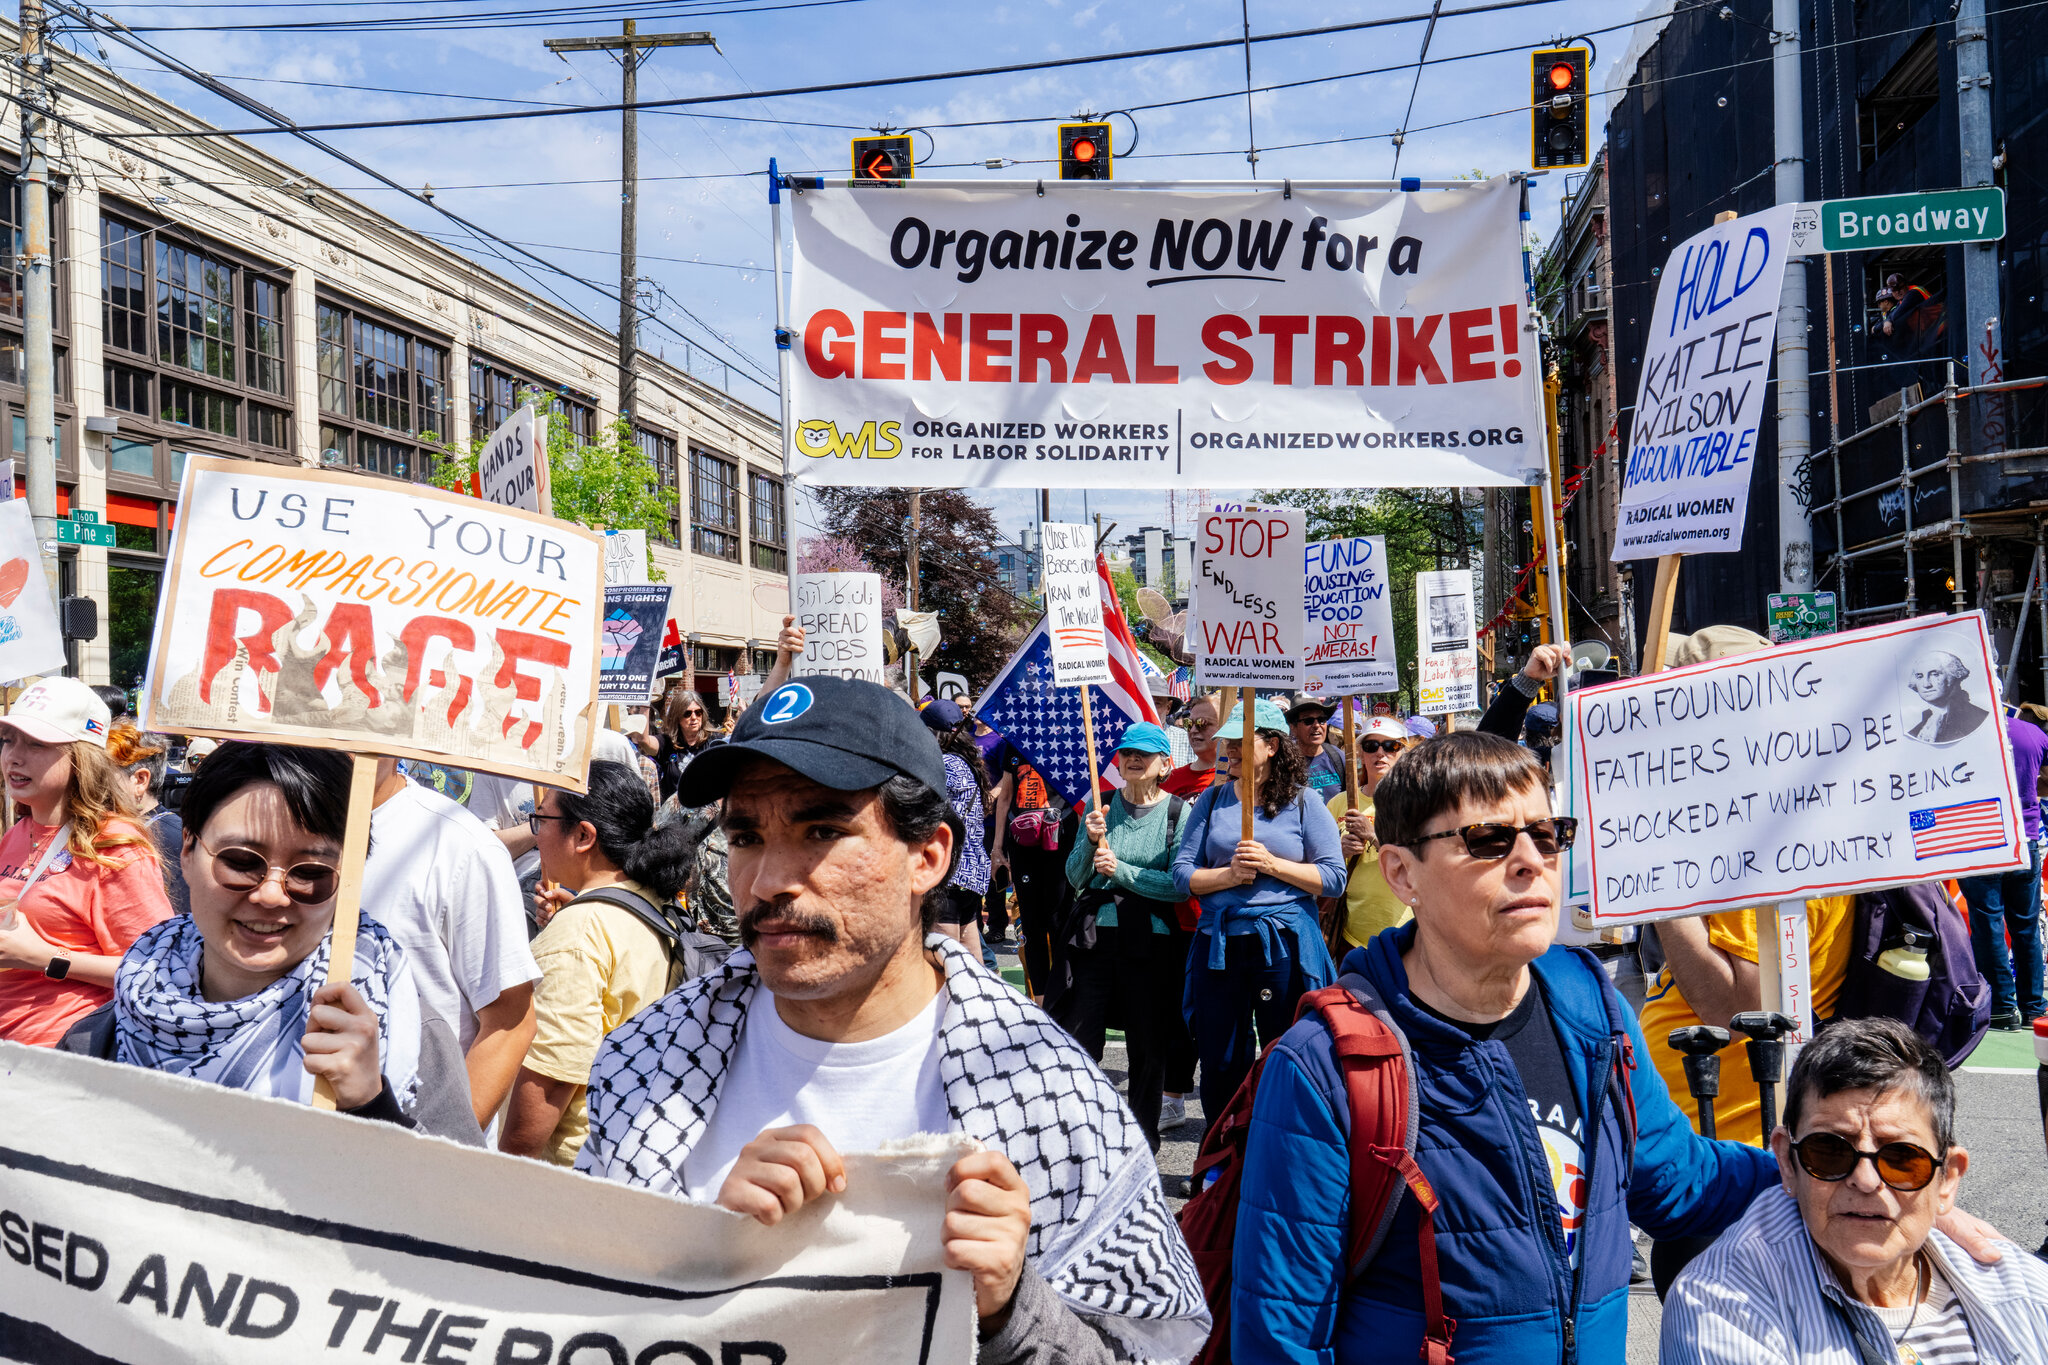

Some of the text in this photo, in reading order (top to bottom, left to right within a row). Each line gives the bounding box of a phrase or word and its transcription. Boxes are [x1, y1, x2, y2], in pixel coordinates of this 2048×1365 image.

[1792, 220, 1817, 230] RTS
[1839, 206, 1989, 239] Broadway
[890, 213, 1423, 283] Organize NOW for a
[1669, 226, 1770, 338] HOLD
[804, 303, 1522, 387] GENERAL STRIKE!
[1640, 312, 1772, 412] KATIE
[1633, 380, 1751, 447] WILSON
[912, 420, 1169, 440] ORGANIZED WORKERS
[1190, 426, 1524, 449] ORGANIZEDWORKERS.ORG
[482, 426, 523, 493] HANDS
[912, 444, 1170, 461] FOR LABOR SOLIDARITY
[1624, 428, 1755, 488] ACCOUNTABLE
[505, 465, 535, 506] OUR
[77, 512, 94, 522] 1600
[1625, 498, 1735, 525] RADICAL WOMEN
[59, 526, 65, 539] E
[74, 523, 97, 542] Pine
[229, 487, 568, 581] USE YOUR
[1044, 524, 1068, 551] Close
[1204, 516, 1289, 558] STOP
[1622, 526, 1731, 547] www.radicalwomen.org
[1045, 554, 1079, 576] Bases
[1304, 538, 1373, 575] FUND
[199, 539, 580, 636] COMPASSIONATE
[623, 594, 667, 602] RIGHTS!
[1046, 581, 1071, 604] IRAN
[1202, 559, 1277, 619] ENDLESS
[800, 612, 869, 635] BREAD
[1058, 605, 1099, 628] The World!
[1308, 604, 1363, 622] FOOD
[1202, 620, 1285, 655] WAR
[1324, 622, 1363, 642] NOT
[806, 639, 868, 662] JOBS
[1304, 635, 1378, 661] CAMERAS!
[199, 588, 573, 750] RAGE
[1058, 659, 1106, 671] RADICAL WOMEN
[1205, 658, 1295, 669] RADICAL WOMEN
[1205, 671, 1295, 682] www.radicalwomen.org
[1424, 668, 1448, 682] Labor
[628, 674, 648, 682] ONE
[1304, 669, 1394, 692] FSP Freedom Socialist Party
[1445, 684, 1473, 692] ORGANIZED
[771, 690, 799, 720] 2
[1426, 701, 1475, 712] LABOR SOLIDARITY
[1448, 692, 1471, 701] WORKERS
[1586, 661, 1822, 739] OUR FOUNDING
[1374, 706, 1390, 714] STOP
[1594, 714, 1897, 795] FATHERS WOULD BE
[1025, 776, 1039, 808] RESIST
[1599, 761, 1975, 849] SHOCKED AT WHAT IS BEING
[1606, 831, 1894, 904] DONE TO OUR COUNTRY
[1783, 916, 1798, 968] THIS
[0, 1209, 109, 1292] SED
[117, 1253, 300, 1339] AND
[325, 1288, 489, 1365] THE
